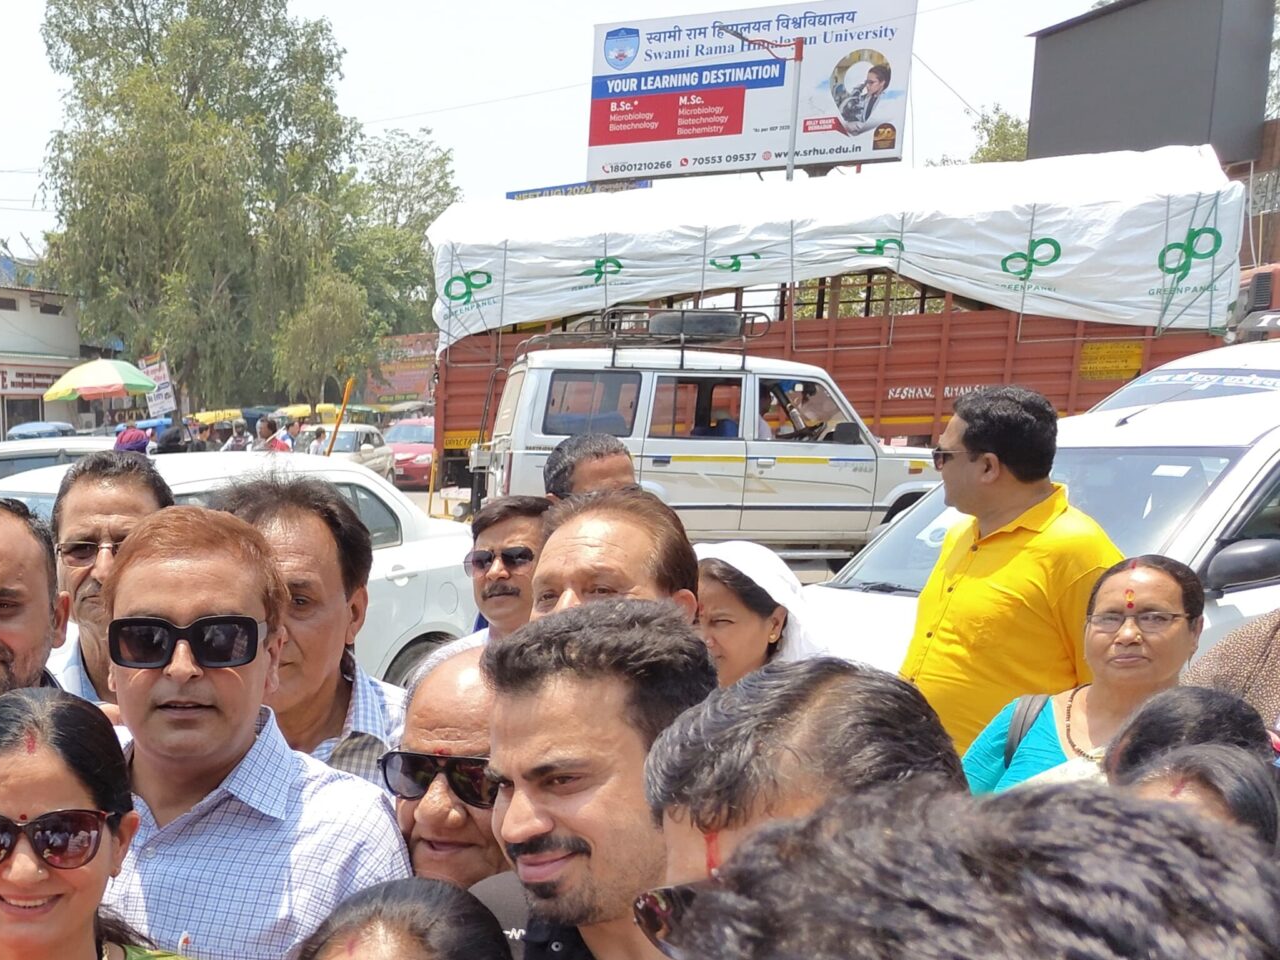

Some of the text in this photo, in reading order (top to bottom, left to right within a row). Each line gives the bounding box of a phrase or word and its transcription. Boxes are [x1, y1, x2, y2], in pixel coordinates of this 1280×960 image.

[646, 25, 682, 44] स्वामी
[686, 26, 708, 40] राम
[776, 11, 857, 31] विश्वविद्यालय
[644, 45, 689, 61] Swami
[695, 43, 735, 57] Rama
[823, 25, 897, 44] University
[607, 64, 780, 93] YOUR LEARNING DESTINATION
[679, 95, 704, 106] M.Sc.
[678, 104, 724, 116] Microbiology
[609, 111, 654, 122] Microbiology
[678, 114, 729, 126] Biotechnology
[609, 120, 659, 132] Biotechnology
[677, 124, 724, 136] Biochemistry
[692, 152, 757, 166] 70553 09537
[610, 160, 672, 173] 18001210266
[1148, 284, 1219, 297] GREENPANEL
